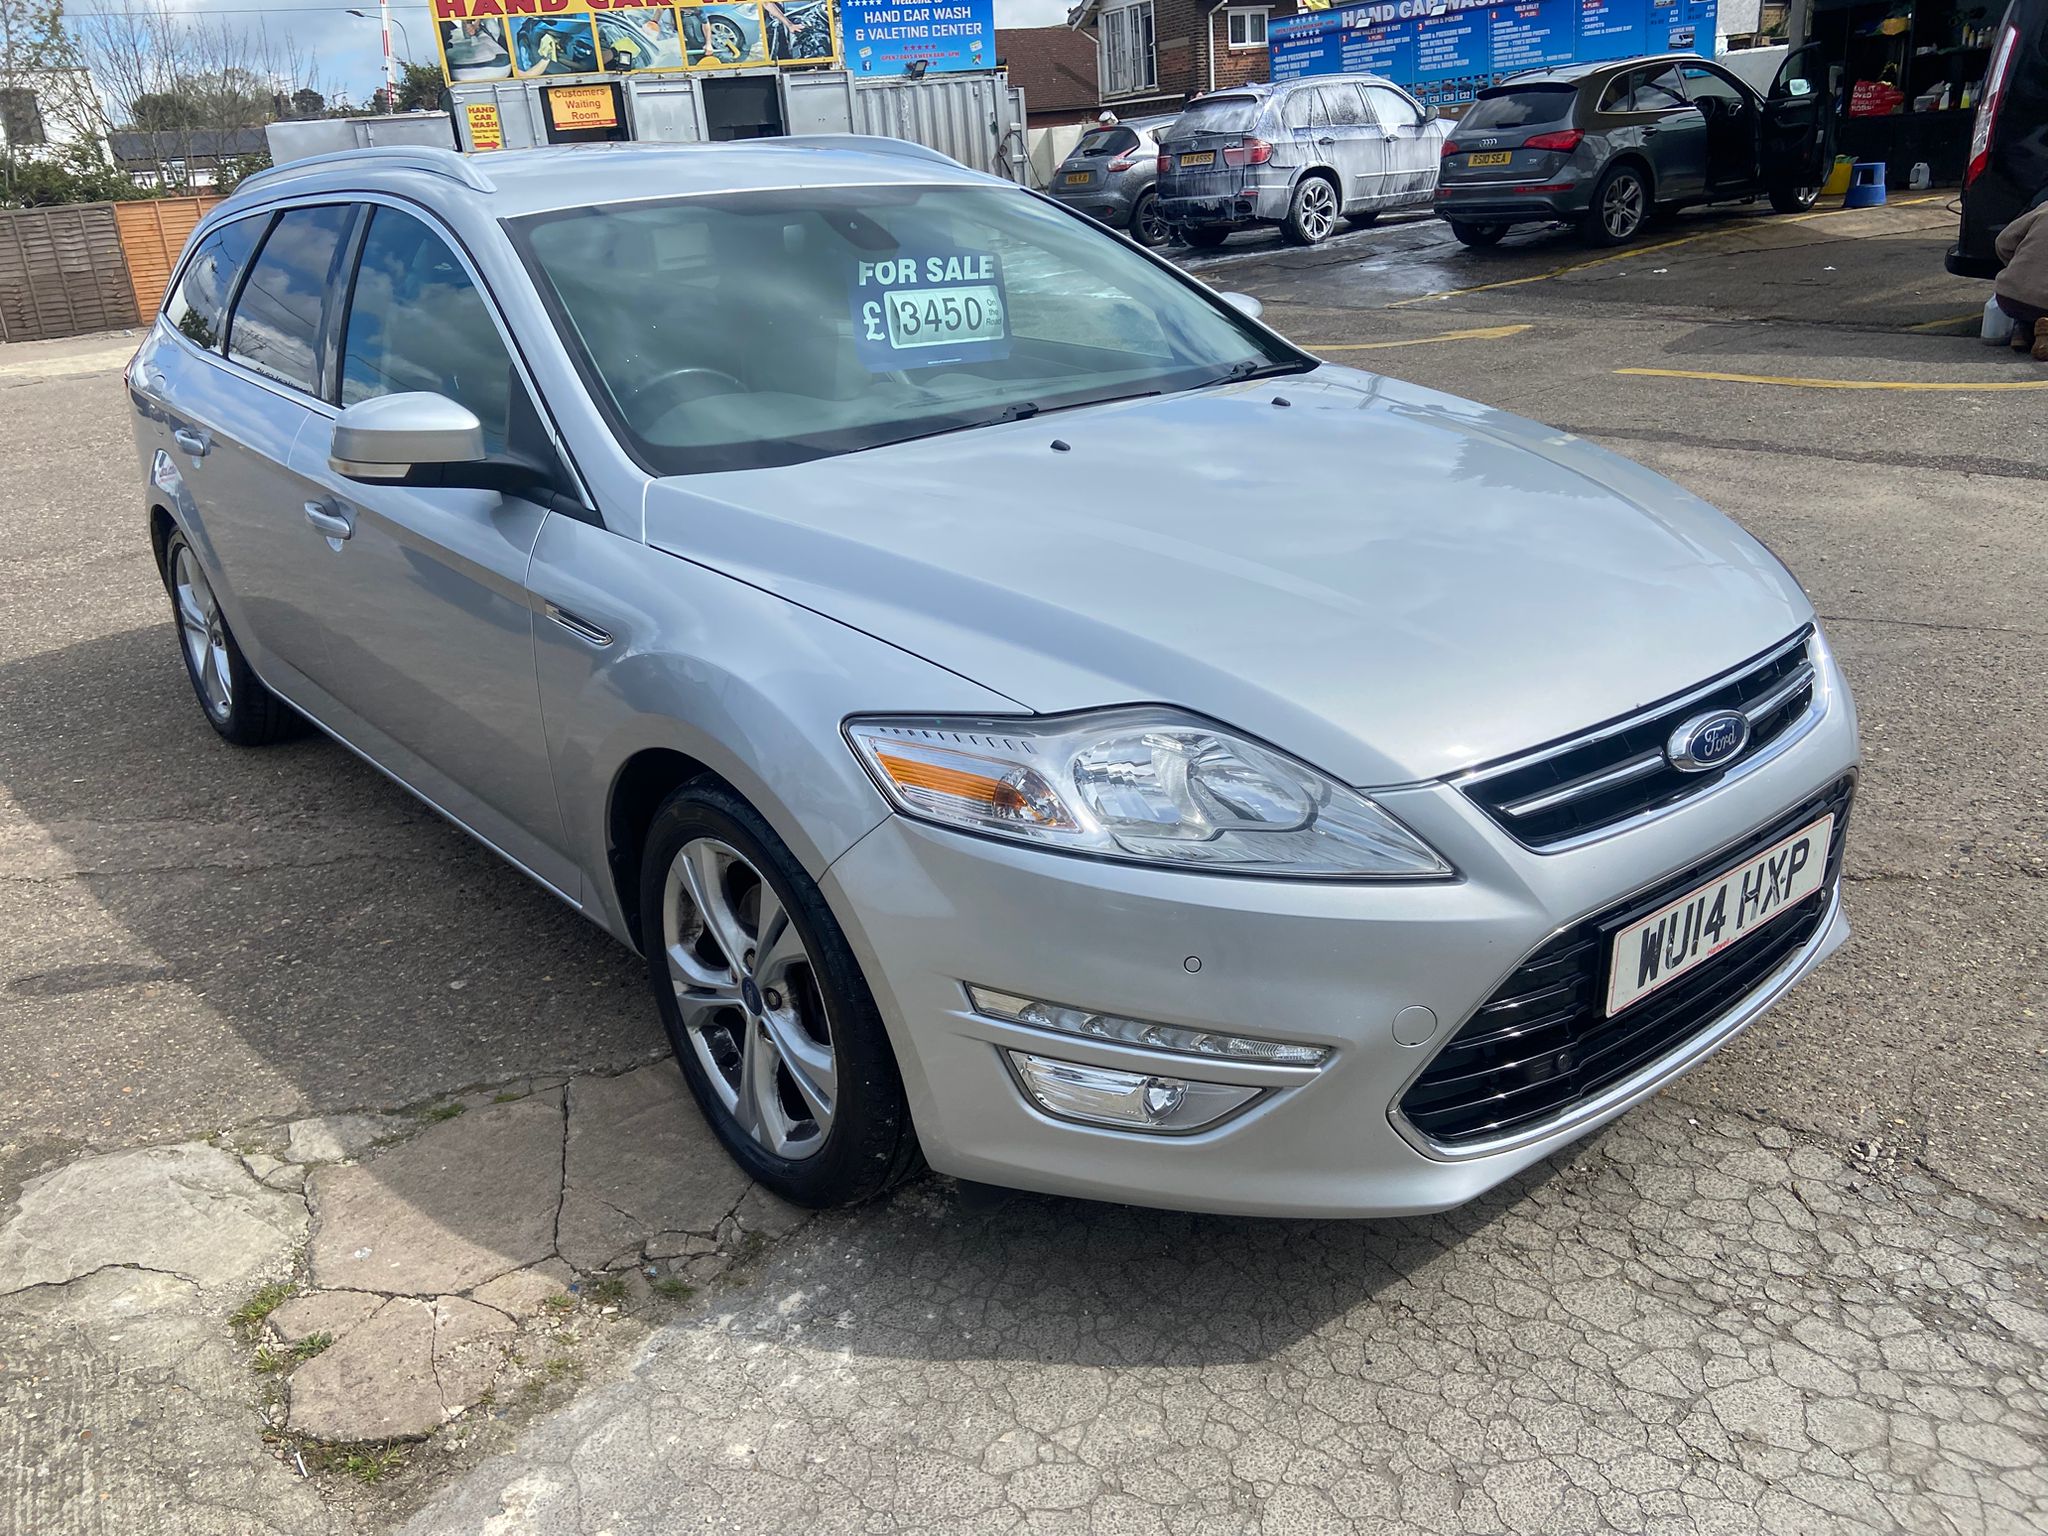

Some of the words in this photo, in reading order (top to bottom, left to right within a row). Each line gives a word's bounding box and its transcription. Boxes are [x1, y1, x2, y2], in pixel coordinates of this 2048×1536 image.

[864, 10, 900, 24] HAND
[903, 8, 930, 21] CAR
[933, 6, 971, 20] WASH
[1342, 4, 1396, 28] HAND
[1399, 0, 1438, 18] CAR
[855, 29, 864, 41] &
[867, 25, 929, 40] VALETING
[932, 22, 982, 37] CENTER
[554, 88, 605, 99] Customers
[468, 106, 496, 114] HAND
[565, 100, 601, 110] Waiting
[572, 112, 600, 120] Room
[1491, 154, 1506, 163] SEA
[858, 258, 918, 286] FOR
[926, 255, 995, 283] SALE
[986, 299, 996, 307] On
[862, 301, 886, 341] £
[900, 296, 982, 336] 3450
[986, 318, 1001, 326] Road
[1705, 723, 1737, 756] Ford
[1637, 884, 1727, 990] WU14
[1736, 837, 1811, 931] HXP
